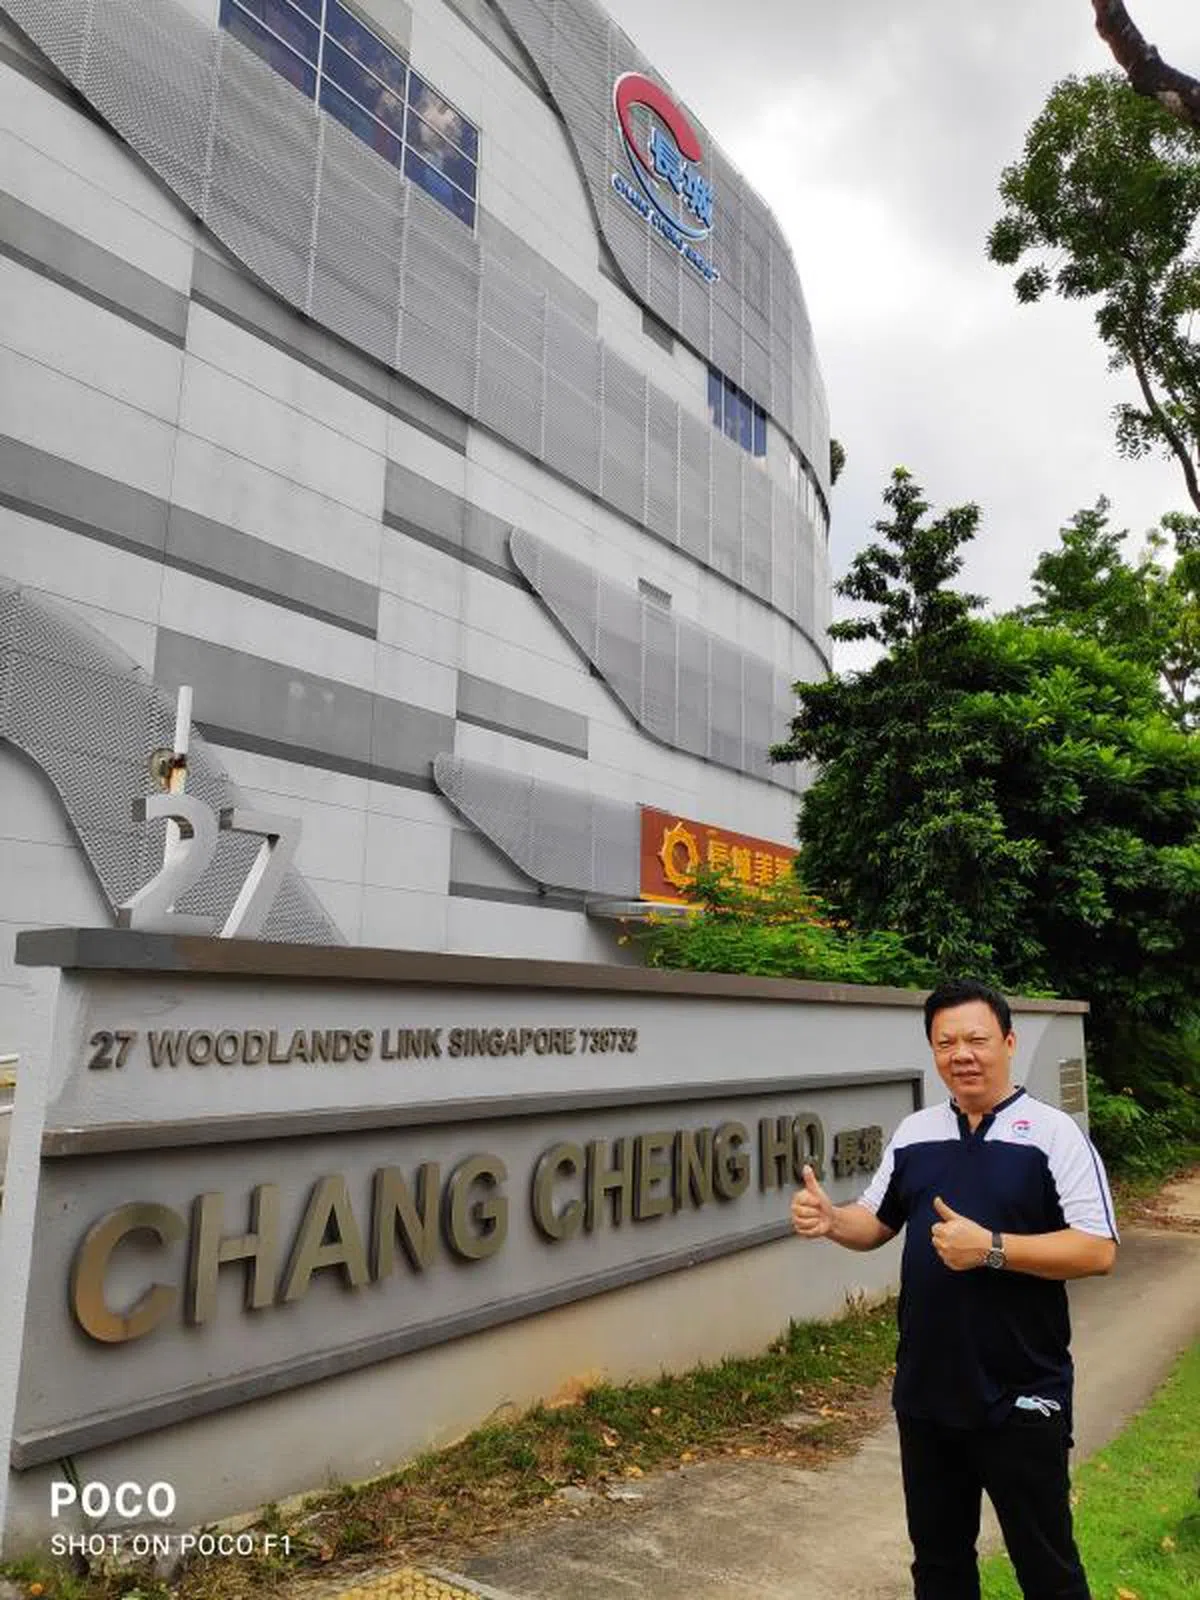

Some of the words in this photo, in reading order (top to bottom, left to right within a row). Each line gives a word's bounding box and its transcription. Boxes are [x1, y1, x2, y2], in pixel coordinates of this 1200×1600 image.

[116, 793, 301, 938] 27
[88, 1030, 137, 1071] 27
[148, 1029, 371, 1070] WOODLANDS
[380, 1027, 443, 1061] LINK
[447, 1026, 577, 1058] SINGAPORE
[70, 1153, 509, 1346] CHANG
[531, 1119, 751, 1242] CHENG
